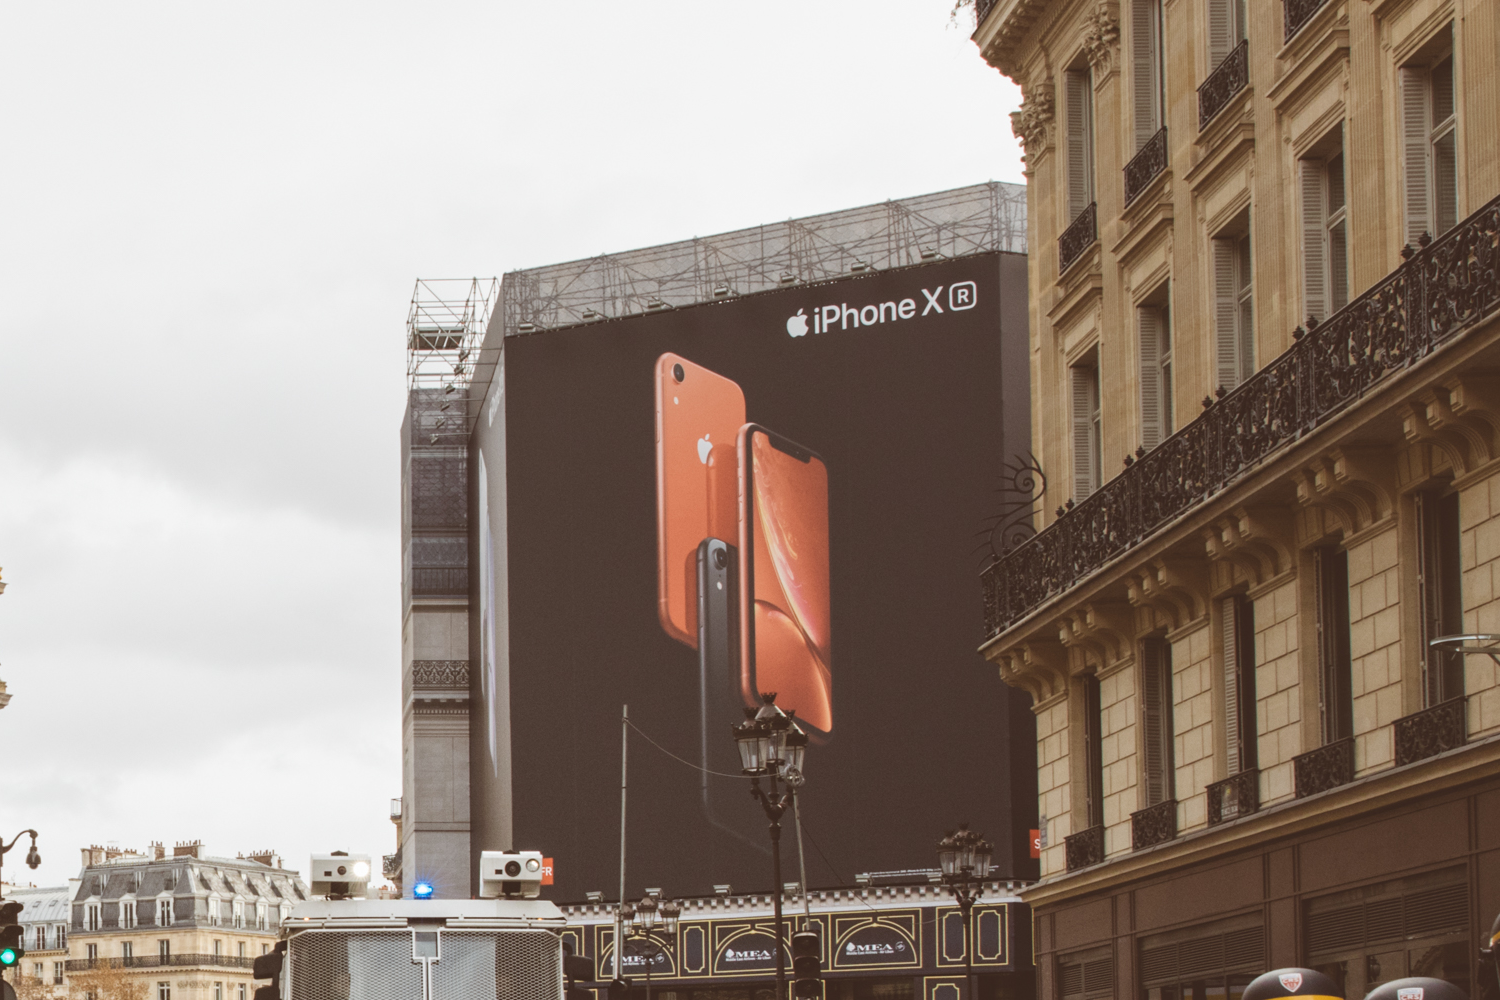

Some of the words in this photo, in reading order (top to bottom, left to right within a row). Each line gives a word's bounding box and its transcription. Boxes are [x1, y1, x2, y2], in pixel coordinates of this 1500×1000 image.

[814, 298, 916, 334] iPhone
[856, 943, 893, 951] MEA
[735, 949, 770, 957] MEA
[1282, 976, 1299, 984] CRS
[1400, 993, 1420, 1000] CRS
